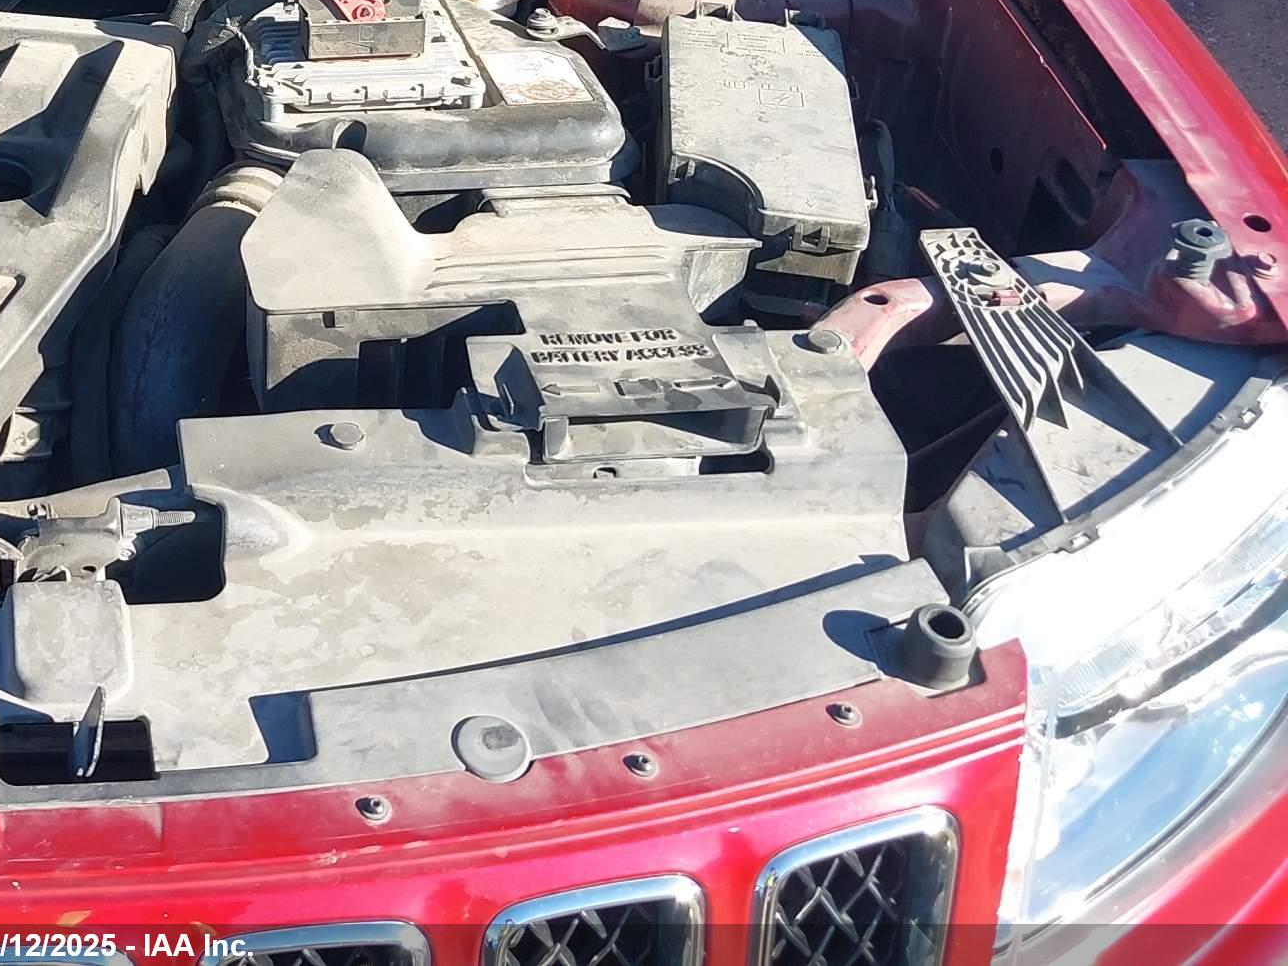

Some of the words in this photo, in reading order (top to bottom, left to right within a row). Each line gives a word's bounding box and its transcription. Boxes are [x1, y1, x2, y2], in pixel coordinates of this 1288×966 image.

[539, 331, 632, 345] REMOVE
[630, 328, 678, 343] FOR
[530, 349, 620, 363] BATTERY
[625, 344, 711, 361] ACCESS
